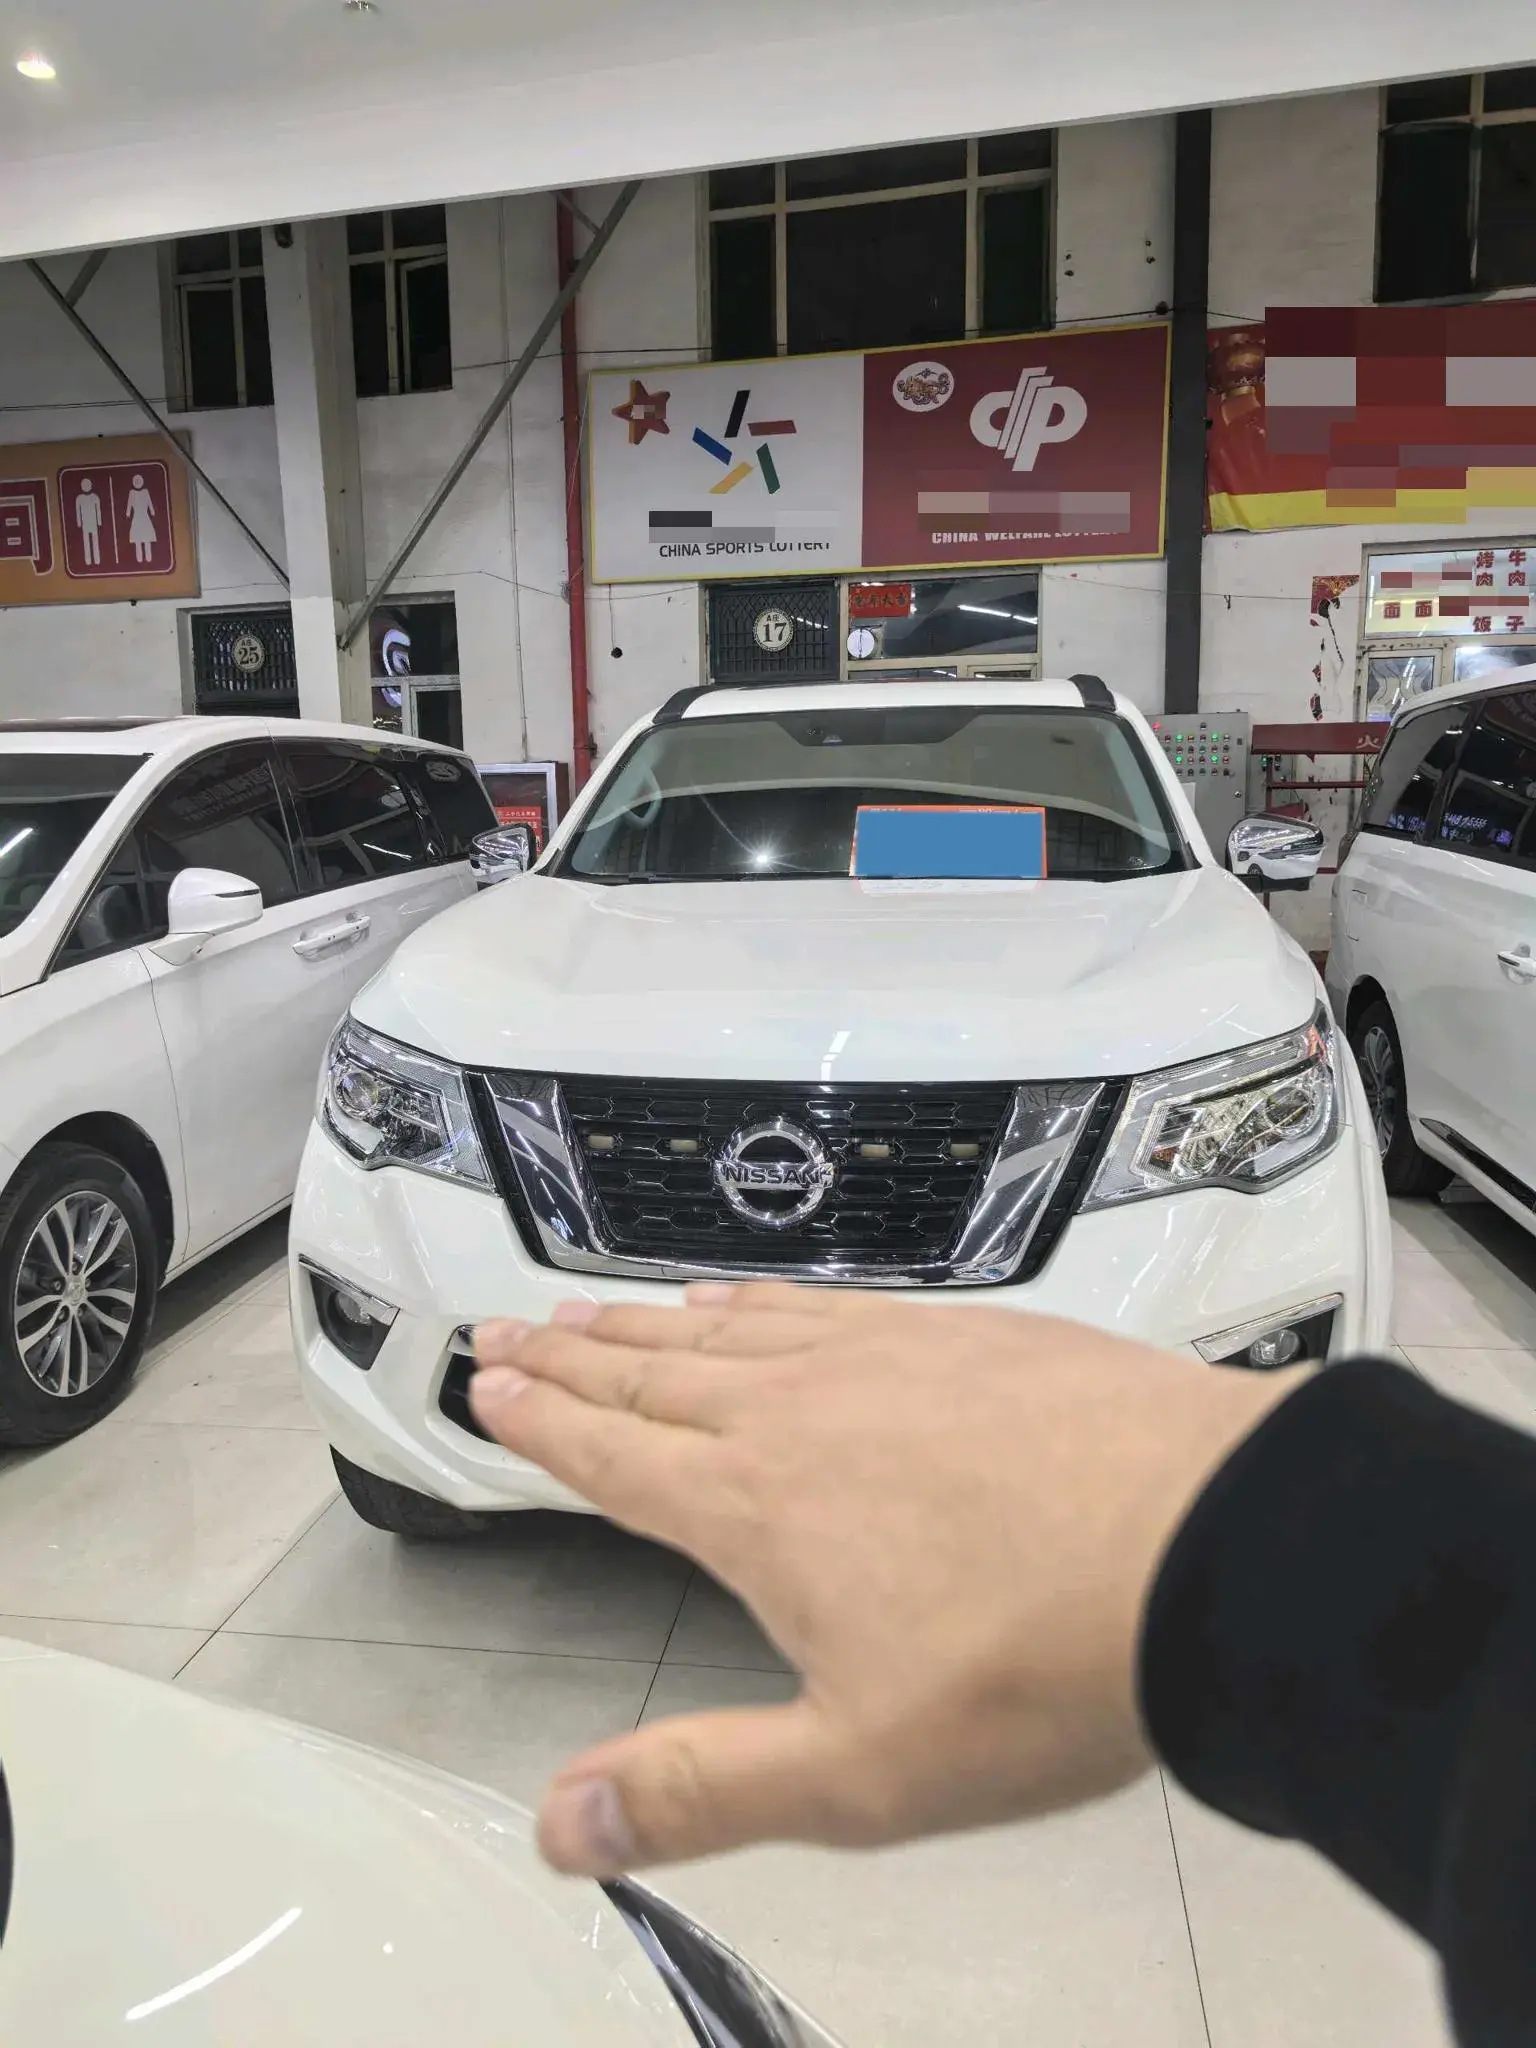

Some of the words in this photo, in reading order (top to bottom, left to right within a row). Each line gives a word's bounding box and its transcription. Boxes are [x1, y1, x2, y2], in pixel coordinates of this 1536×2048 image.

[931, 532, 979, 545] CHINA
[659, 542, 702, 558] CHINA
[705, 542, 764, 556] SPORTS
[762, 622, 787, 642] 17
[238, 646, 260, 665] 25
[1355, 734, 1381, 749] 火
[724, 1166, 820, 1188] NISSAN
